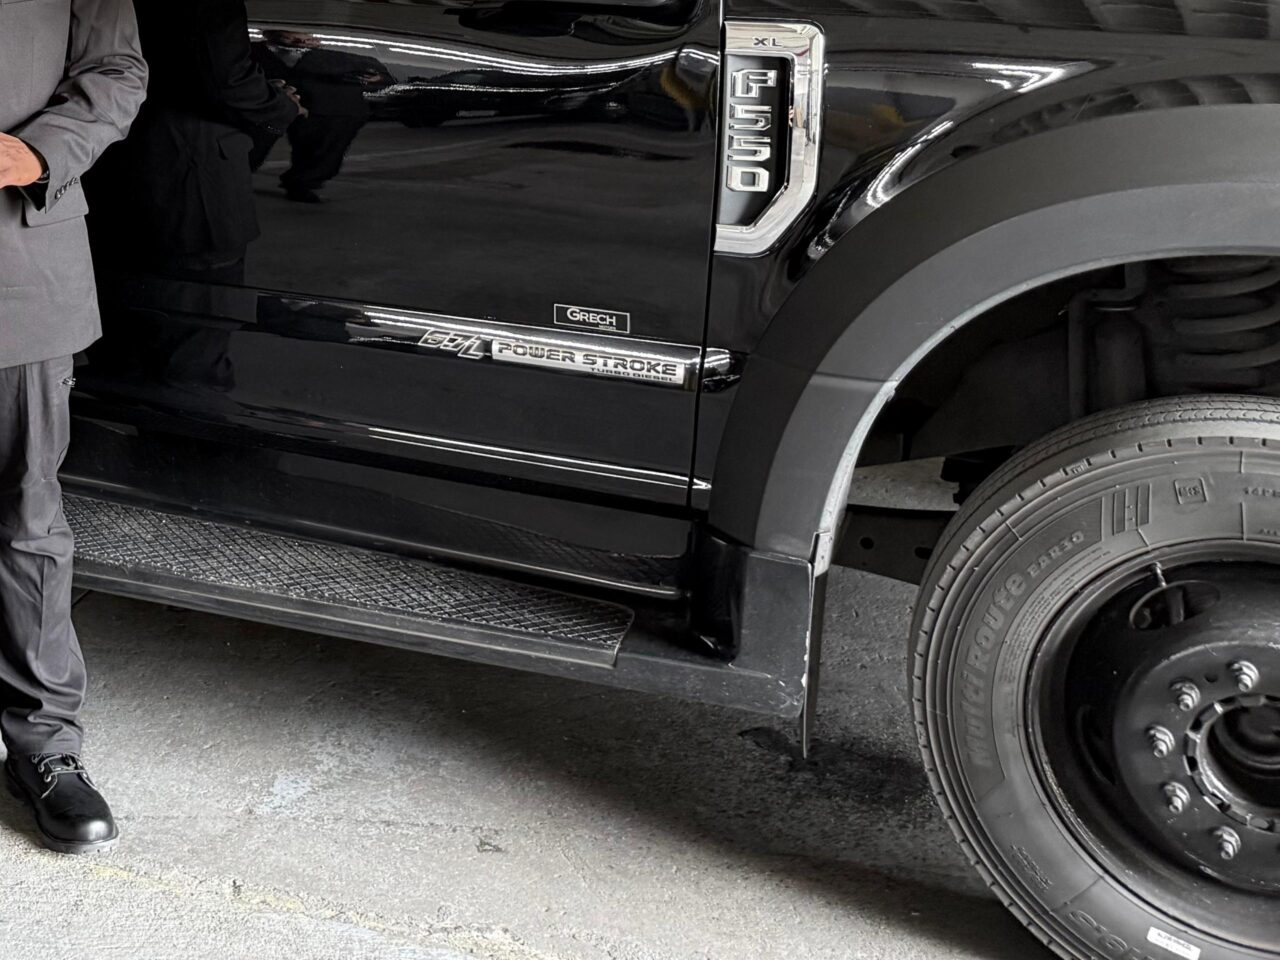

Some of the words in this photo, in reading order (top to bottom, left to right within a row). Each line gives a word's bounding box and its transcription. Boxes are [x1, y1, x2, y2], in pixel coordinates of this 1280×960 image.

[753, 37, 782, 47] XL
[726, 69, 777, 192] F550
[566, 307, 616, 326] GRECH
[497, 342, 575, 363] POWER
[582, 353, 677, 376] STROKE
[590, 367, 630, 376] TURBO
[632, 372, 673, 382] DIESEL
